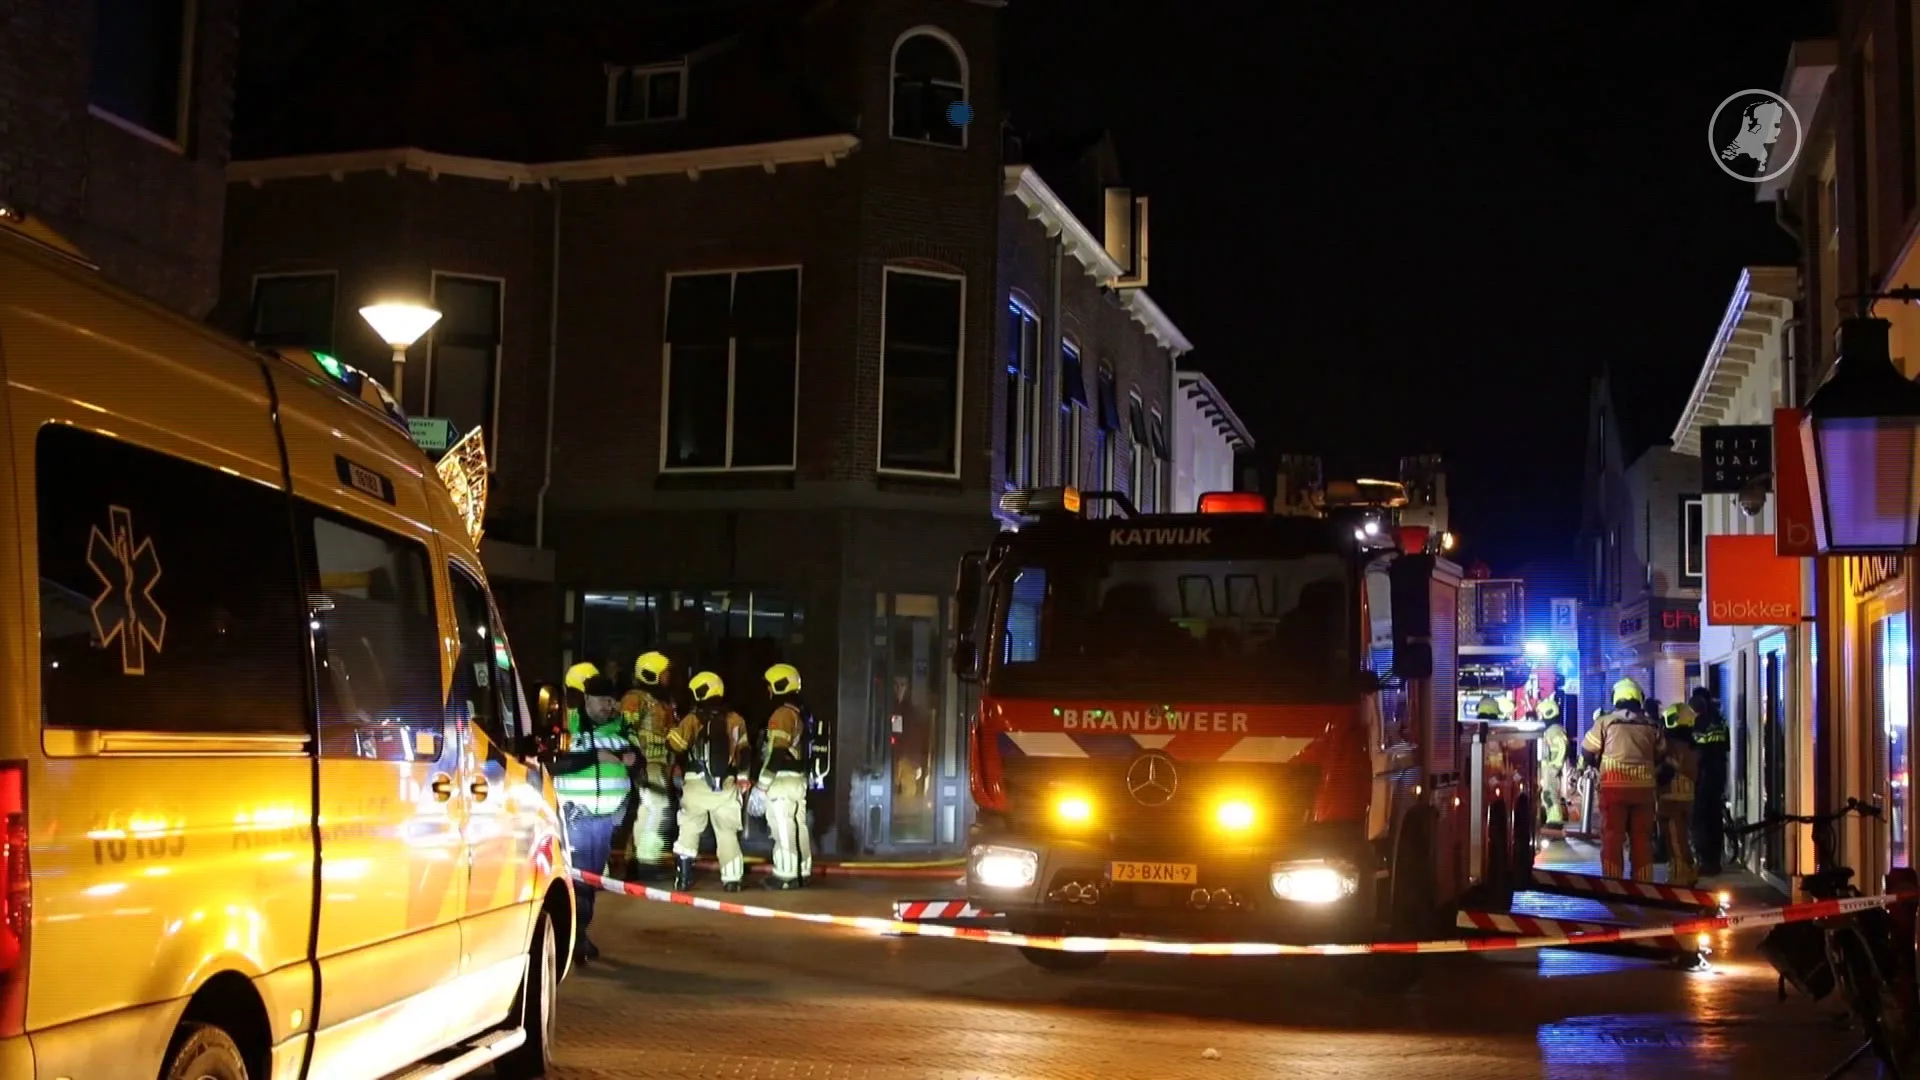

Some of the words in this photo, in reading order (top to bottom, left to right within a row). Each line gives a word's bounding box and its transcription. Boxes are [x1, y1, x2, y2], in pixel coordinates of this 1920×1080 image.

[1110, 527, 1212, 546] KATWIJK
[1063, 709, 1249, 732] BRANDWEER
[1115, 862, 1192, 881] 73-BXN-9
